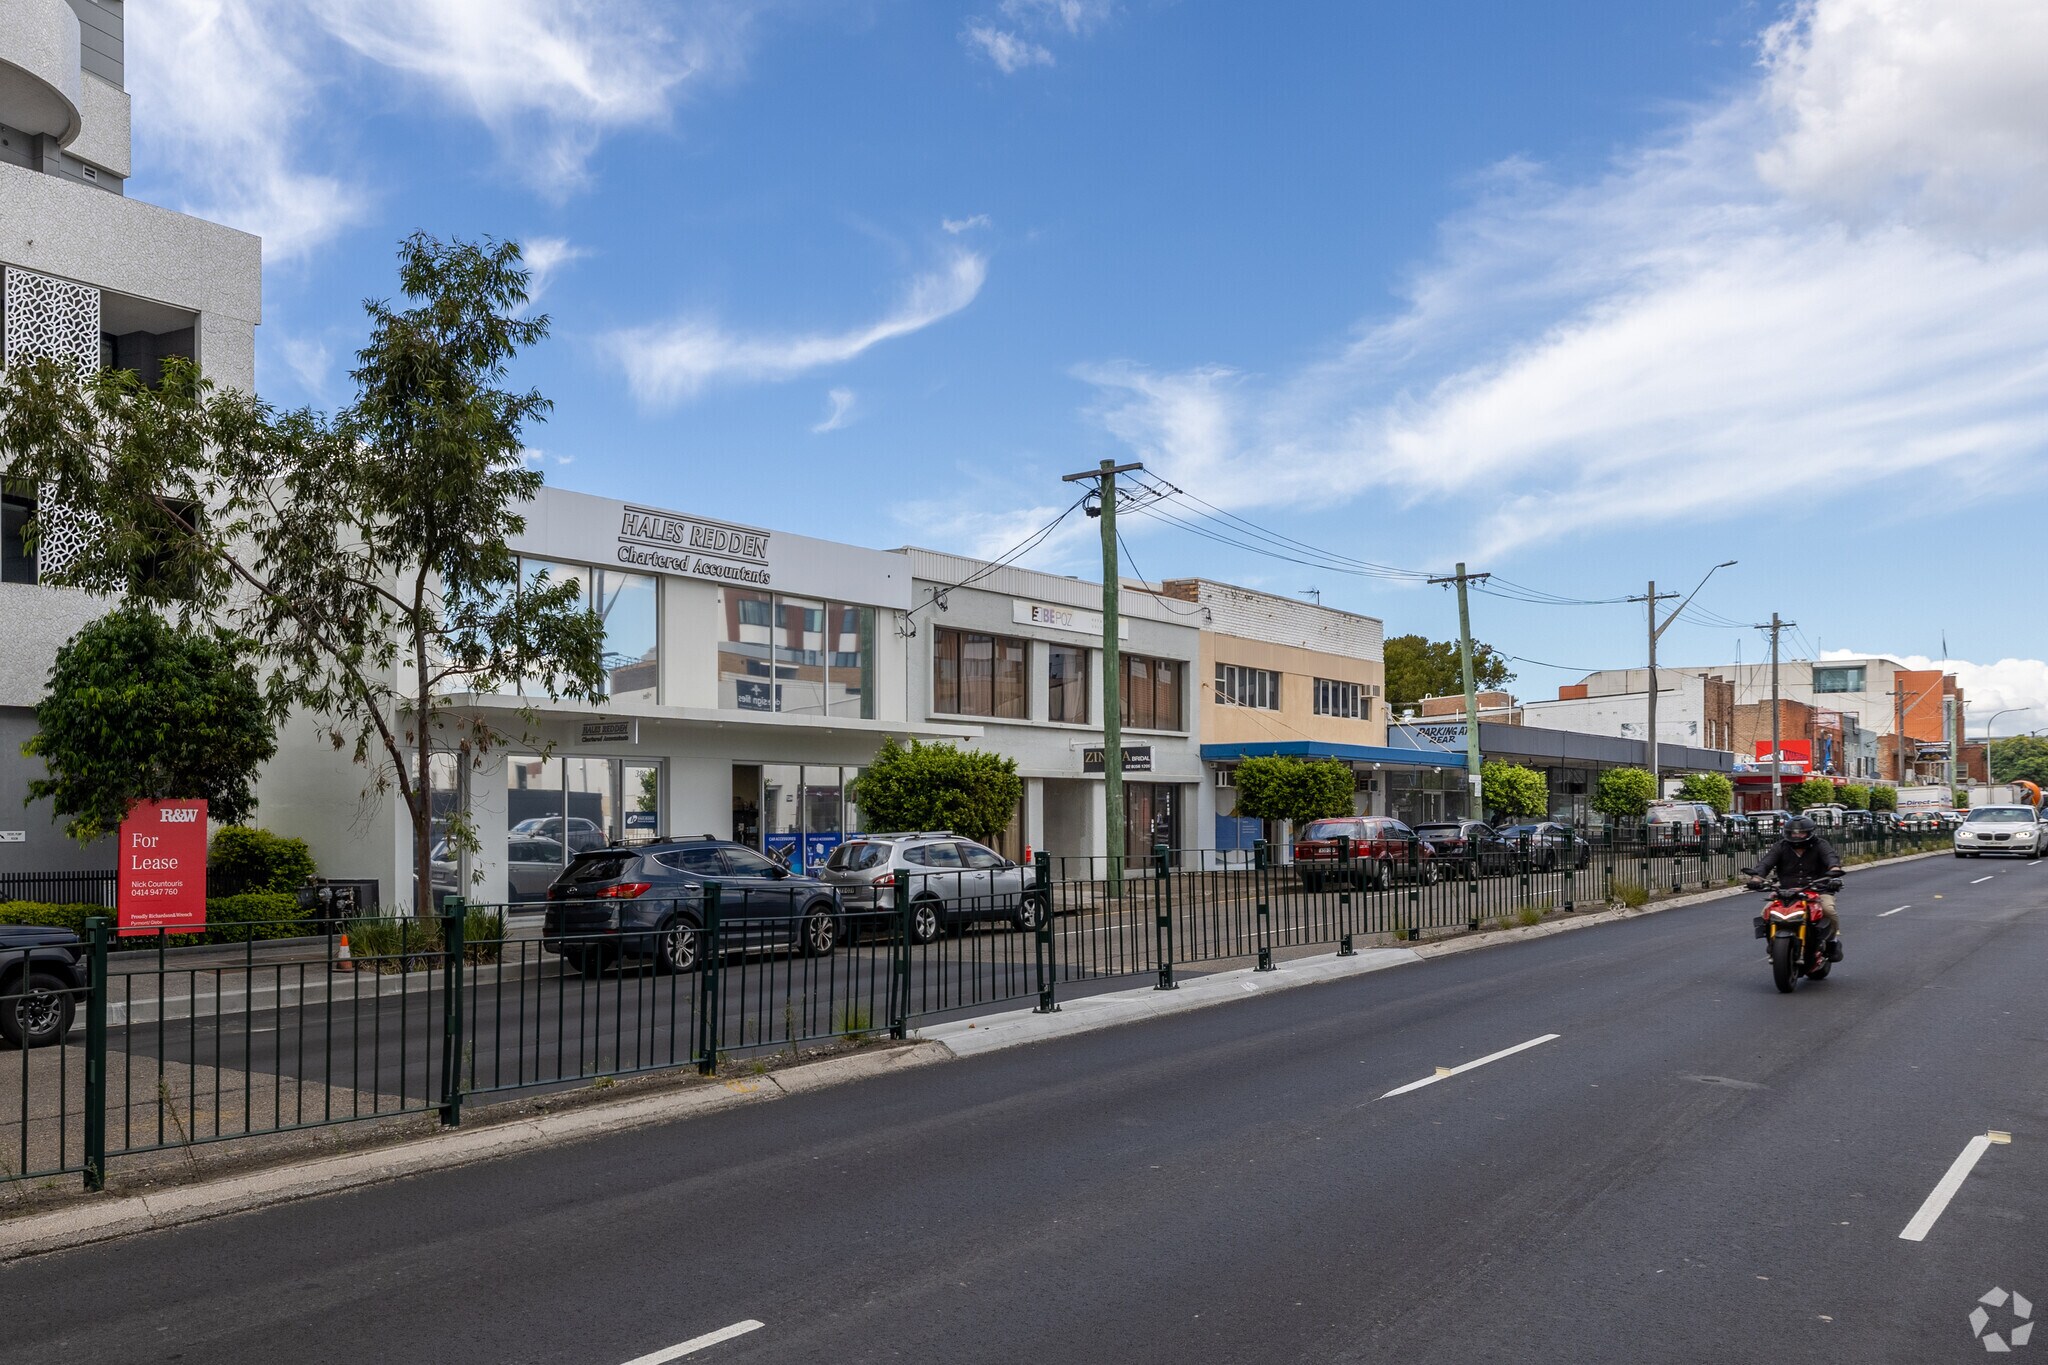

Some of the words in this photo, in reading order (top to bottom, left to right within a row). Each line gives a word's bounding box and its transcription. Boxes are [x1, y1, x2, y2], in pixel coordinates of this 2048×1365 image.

[621, 513, 684, 543] HALES
[690, 525, 768, 558] REDDEN
[618, 545, 690, 571] Chartered
[693, 559, 771, 584] Accountants
[602, 724, 628, 733] REDDEN
[1416, 726, 1458, 737] PARKING
[1429, 735, 1456, 744] REAR
[160, 808, 198, 822] R&W
[132, 833, 159, 848] For
[132, 855, 178, 870] Lease
[131, 880, 146, 888] Nick
[147, 879, 183, 888] Countouris
[131, 888, 149, 896] 0414
[150, 888, 163, 896] 947
